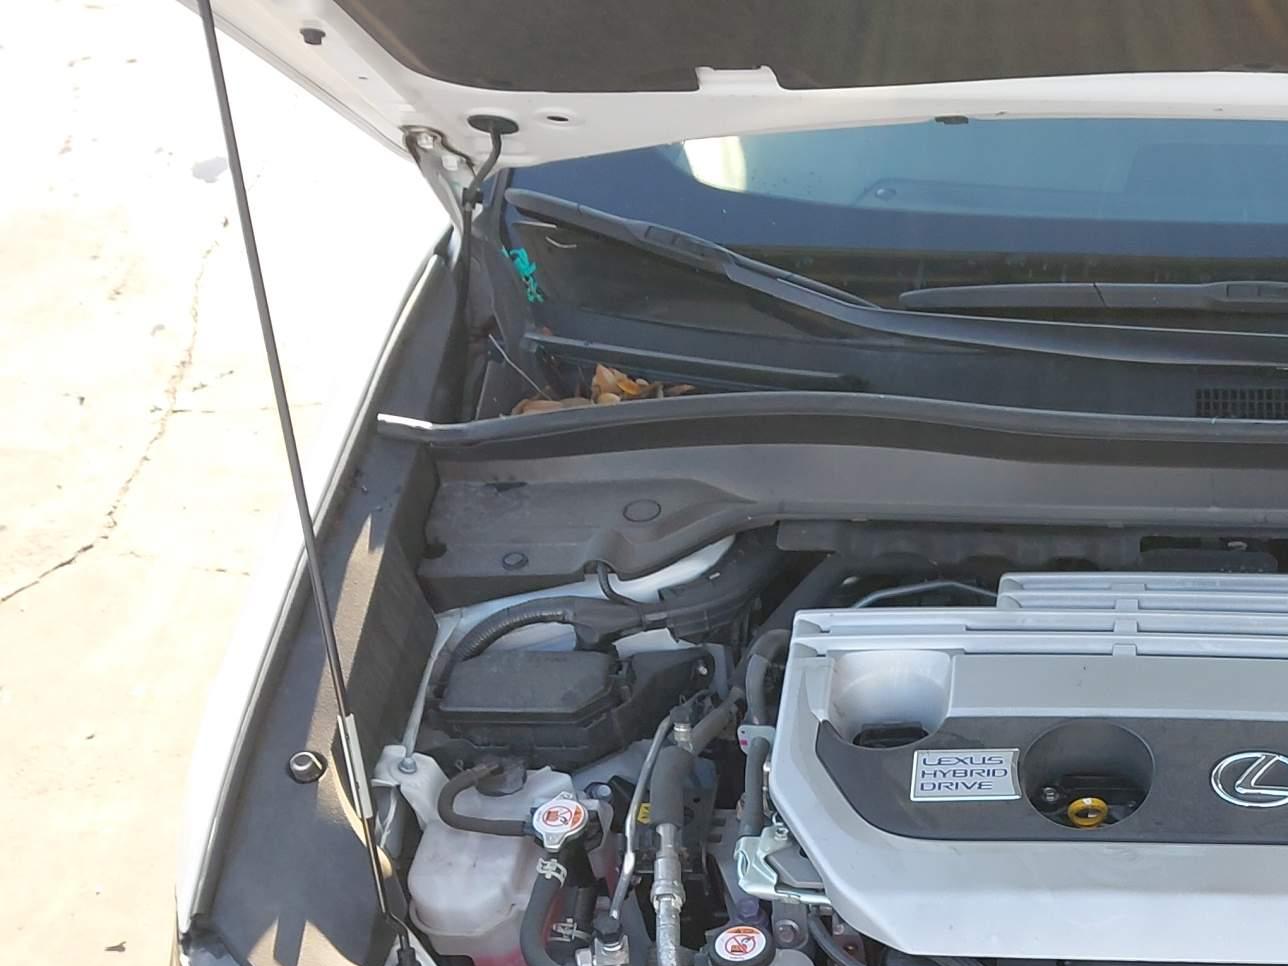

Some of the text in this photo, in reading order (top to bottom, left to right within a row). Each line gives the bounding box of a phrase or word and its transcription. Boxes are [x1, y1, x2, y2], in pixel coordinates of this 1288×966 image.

[922, 756, 1004, 767] LEXUS
[921, 768, 1009, 779] HYBRID
[920, 781, 993, 792] DRIVE
